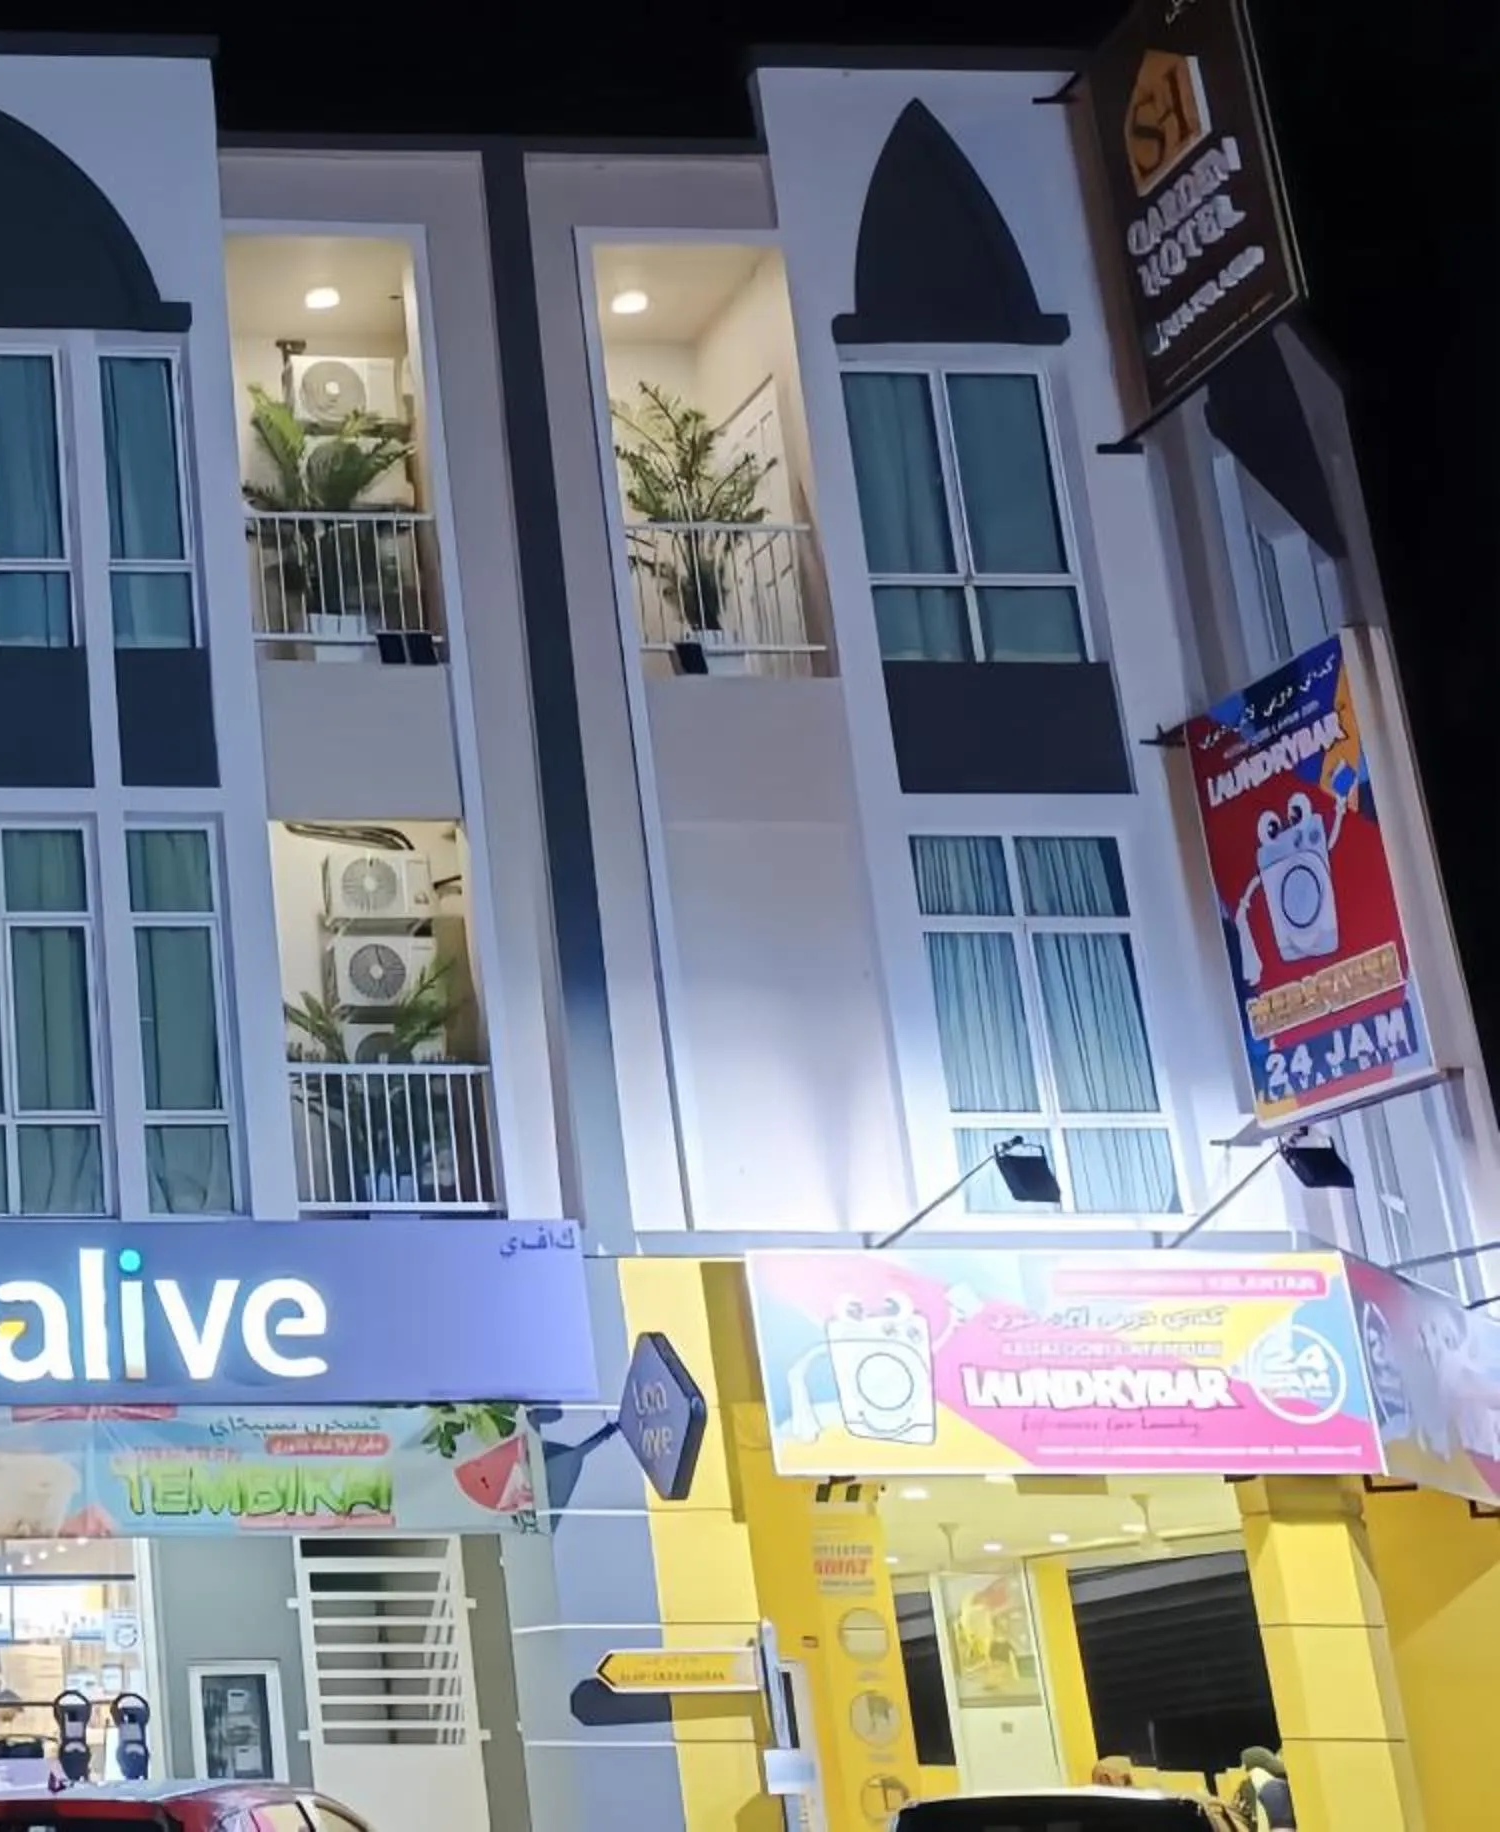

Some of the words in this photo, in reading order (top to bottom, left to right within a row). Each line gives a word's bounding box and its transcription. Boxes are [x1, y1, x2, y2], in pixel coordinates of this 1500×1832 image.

[1265, 1044, 1313, 1085] 24
[1325, 1006, 1410, 1066] JAM
[961, 1364, 1244, 1410] LAUNDRYBAR
